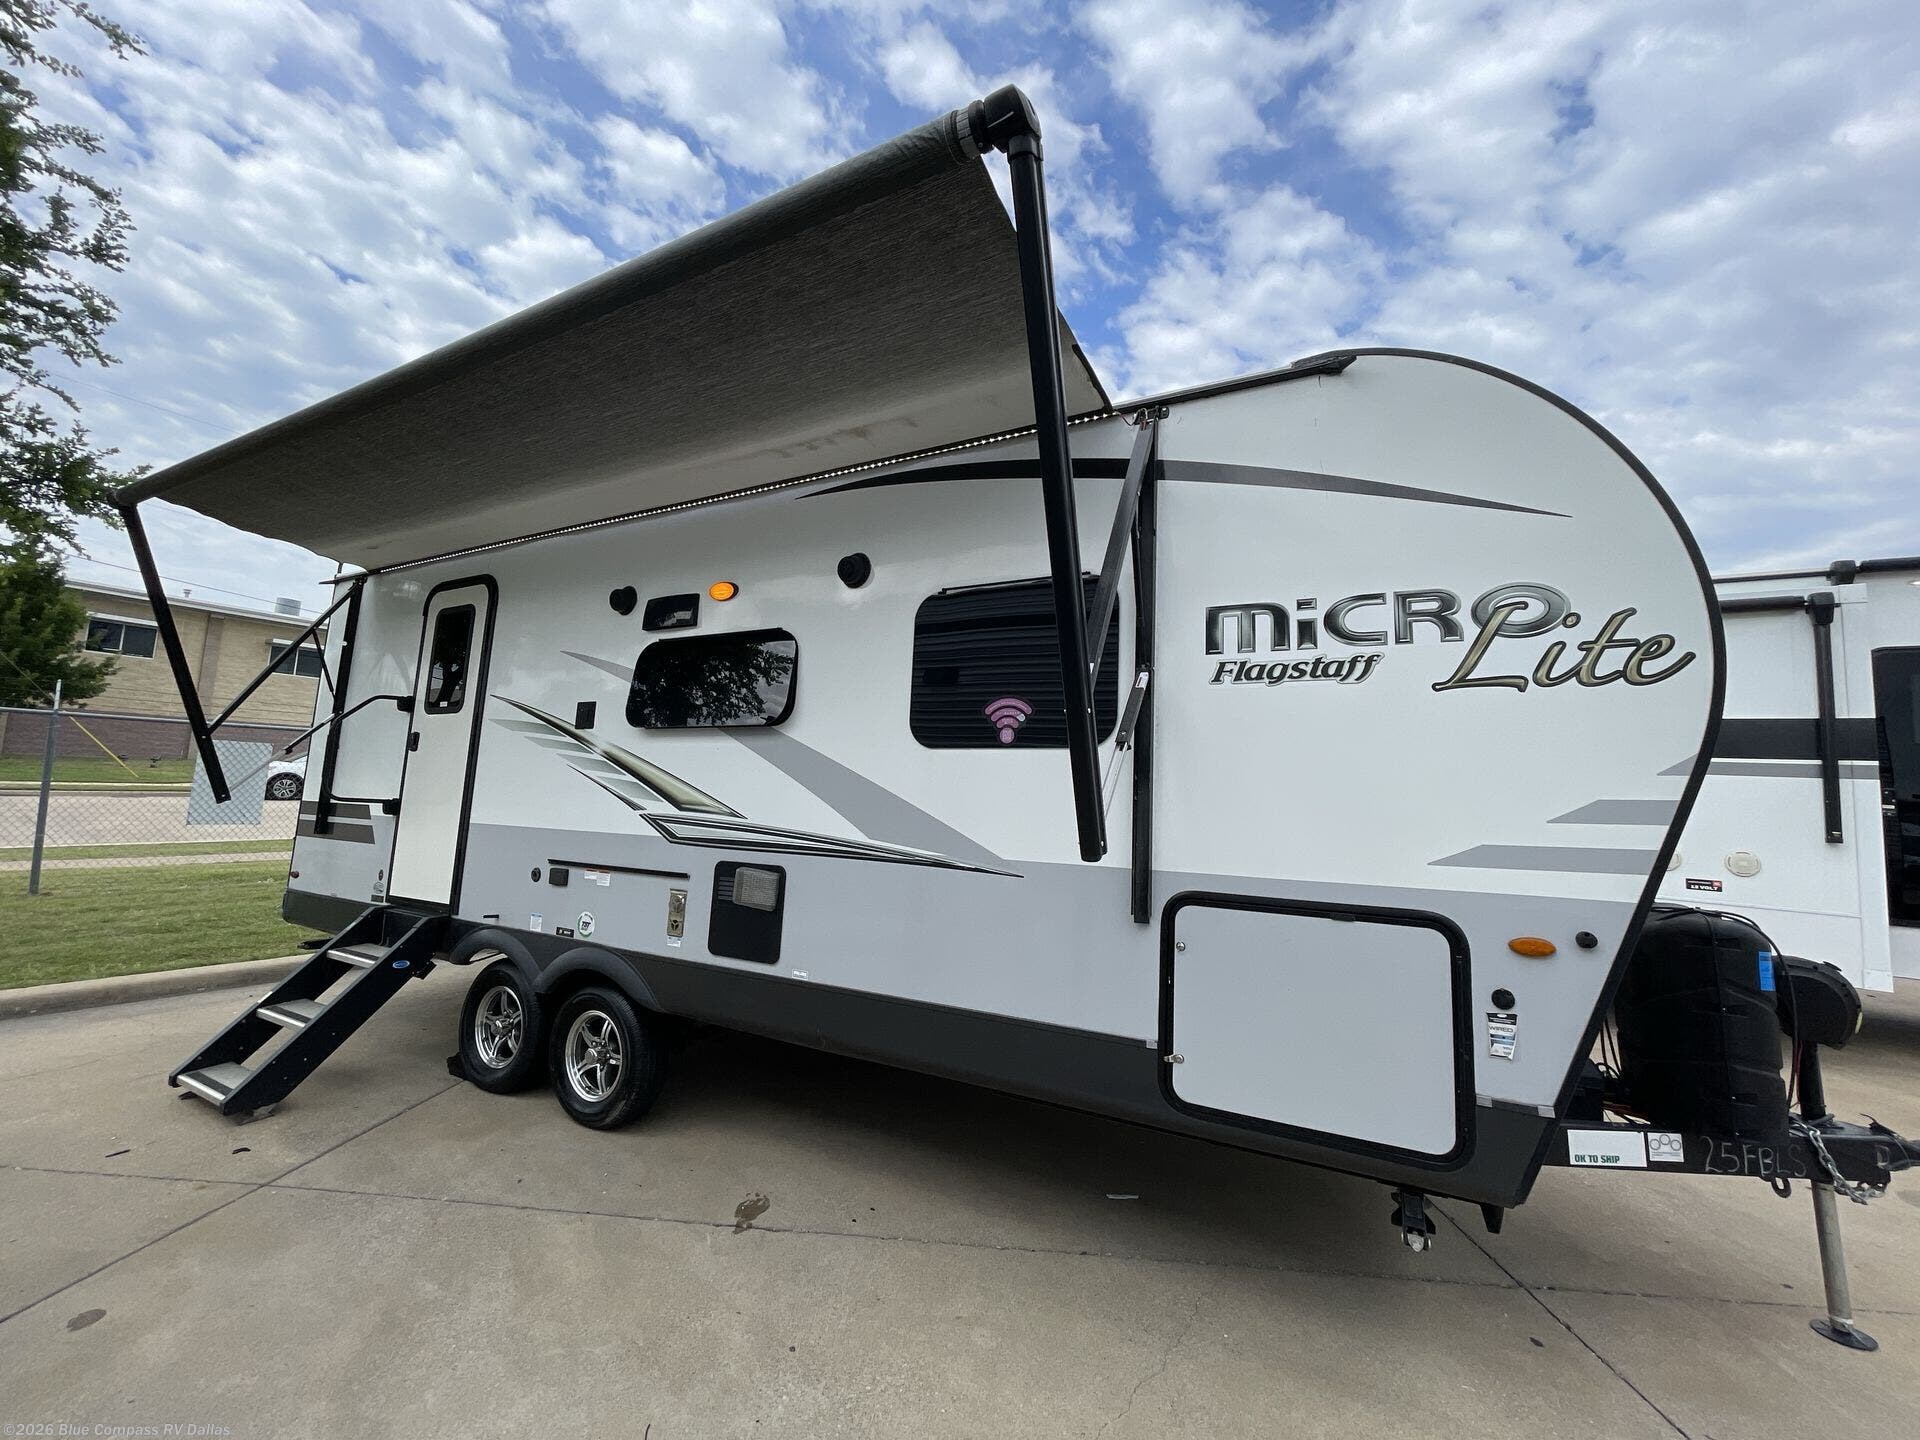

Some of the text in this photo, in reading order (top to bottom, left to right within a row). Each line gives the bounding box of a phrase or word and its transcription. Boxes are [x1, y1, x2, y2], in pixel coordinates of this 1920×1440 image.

[1431, 601, 1696, 692] Lite
[1210, 653, 1383, 686] Flagstaff
[1574, 1154, 1620, 1164] OK TO SHIP
